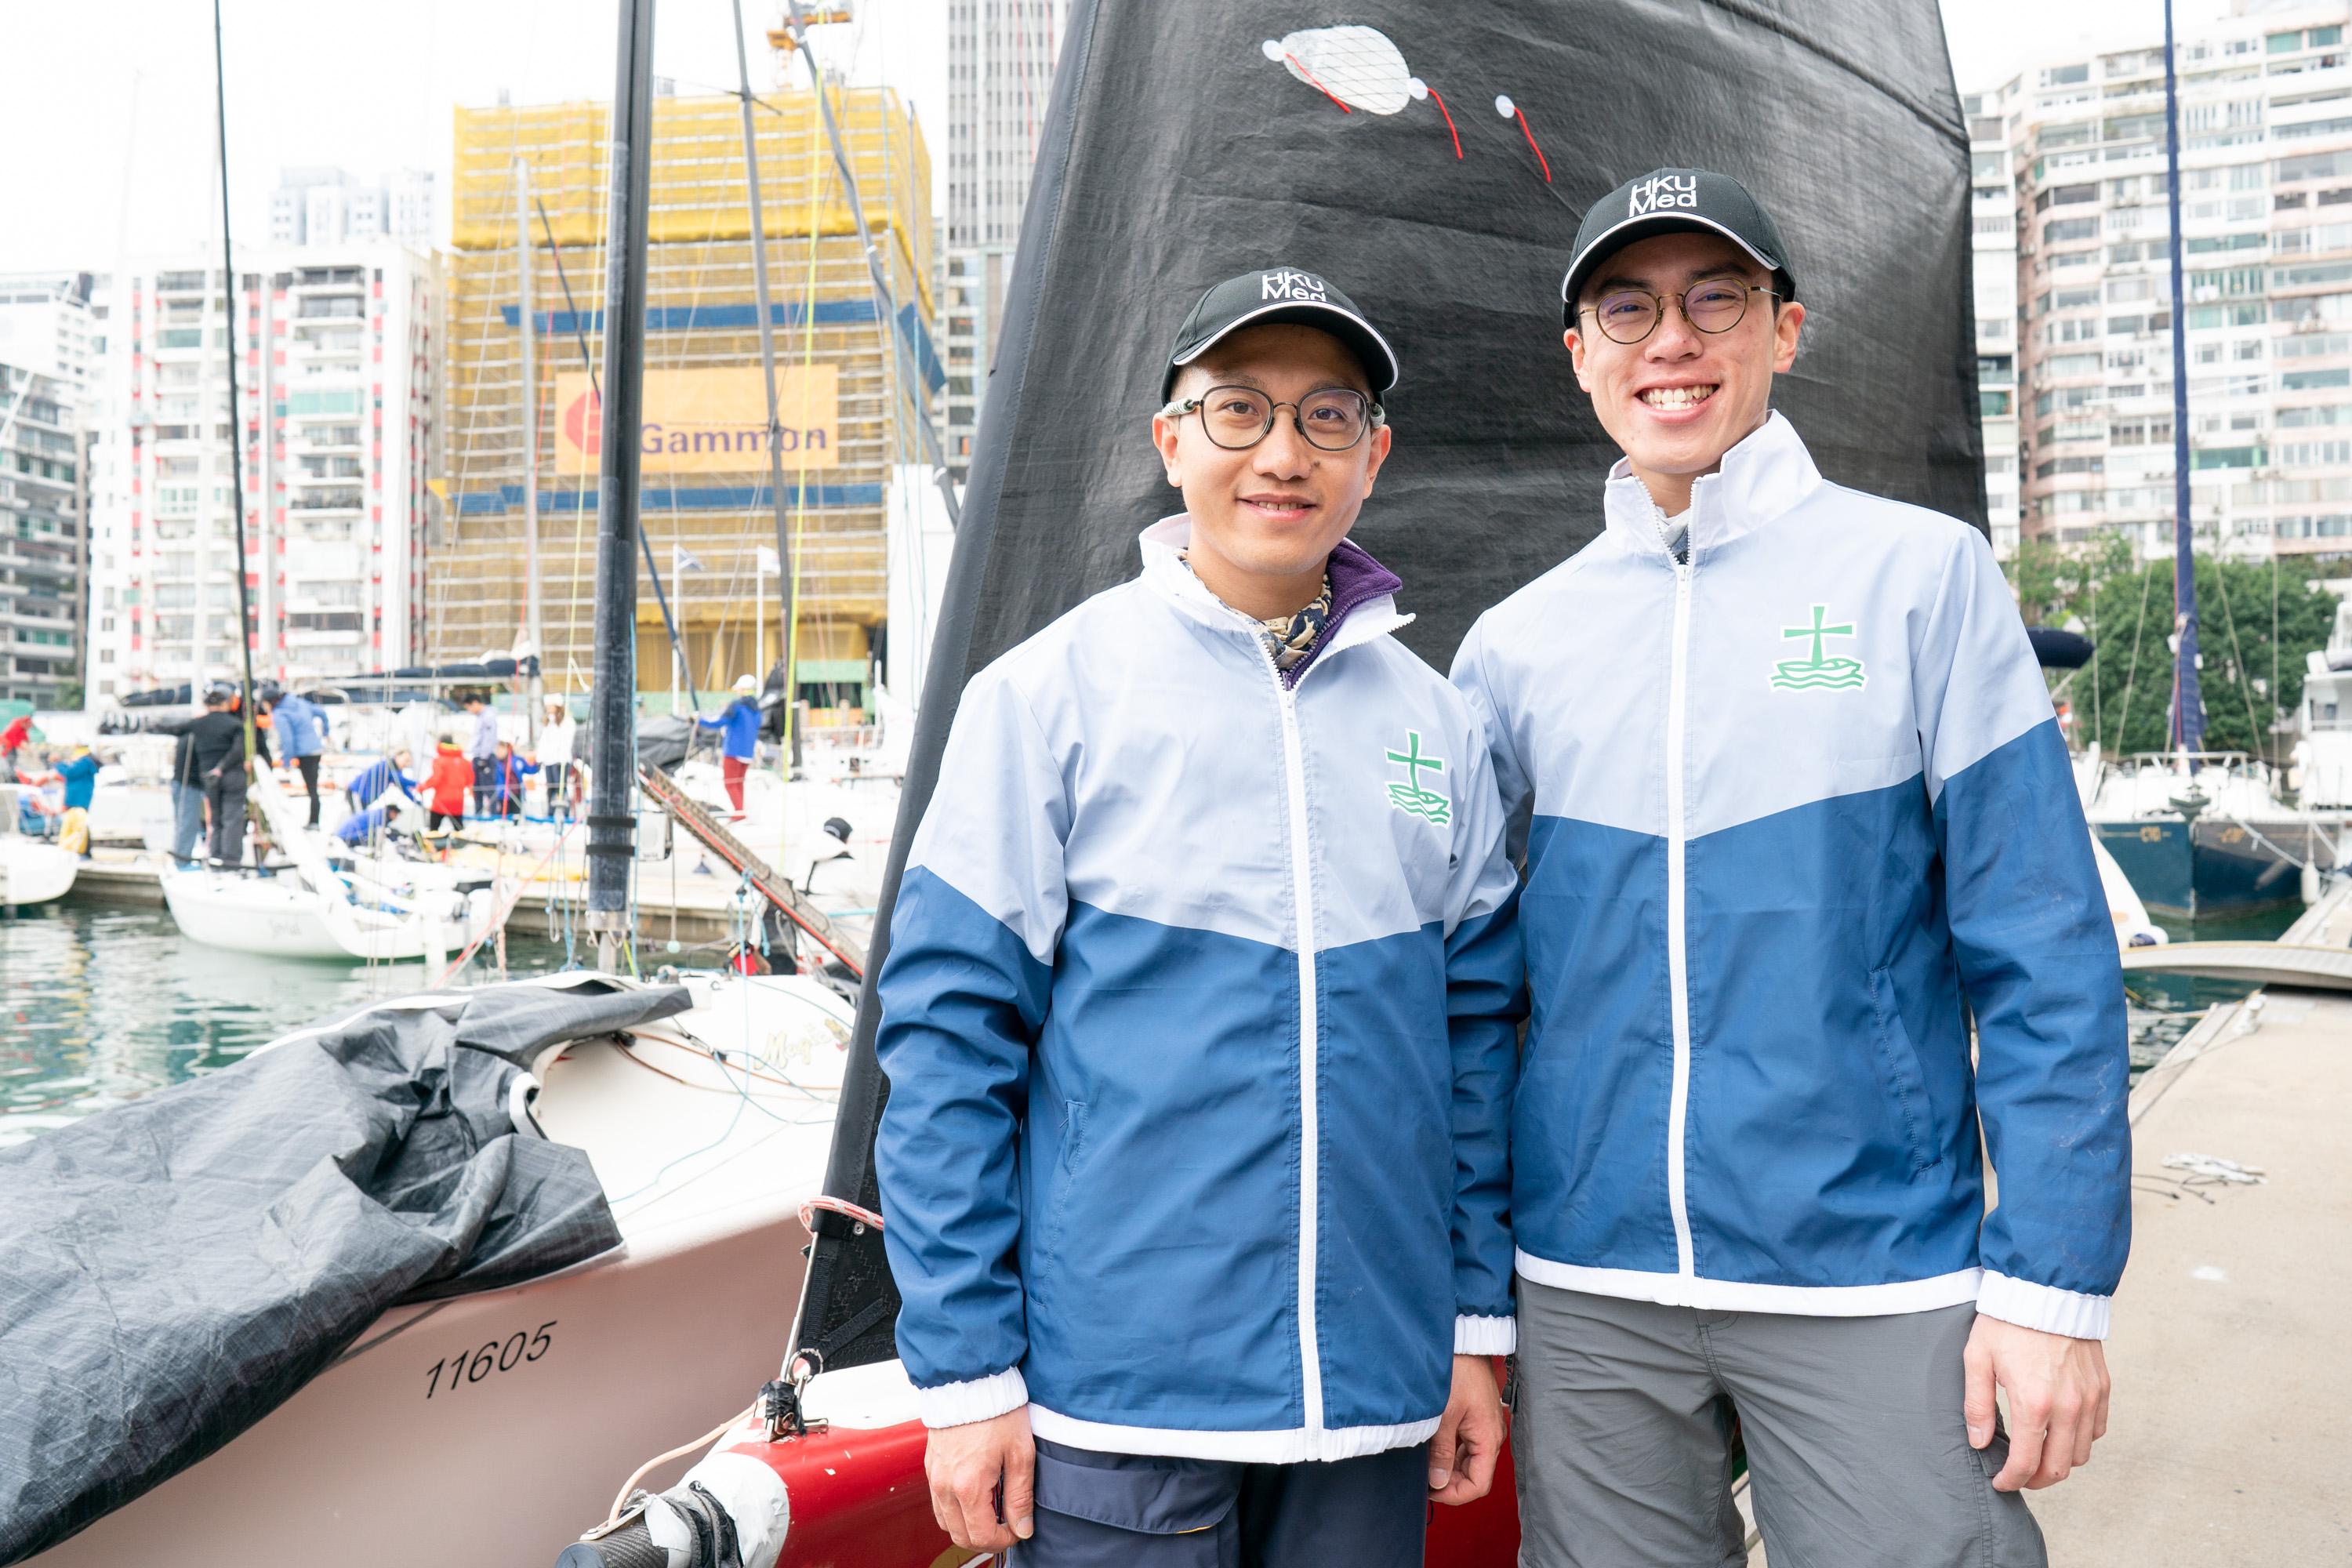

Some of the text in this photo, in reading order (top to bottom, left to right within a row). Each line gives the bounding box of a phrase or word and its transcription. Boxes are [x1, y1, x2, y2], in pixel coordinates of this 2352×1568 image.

[1630, 175, 1697, 199] HKU
[1628, 190, 1697, 218] Med
[1261, 282, 1327, 302] Med
[1262, 270, 1325, 292] HKU
[639, 421, 827, 456] Gammon
[426, 1319, 558, 1399] 11605
